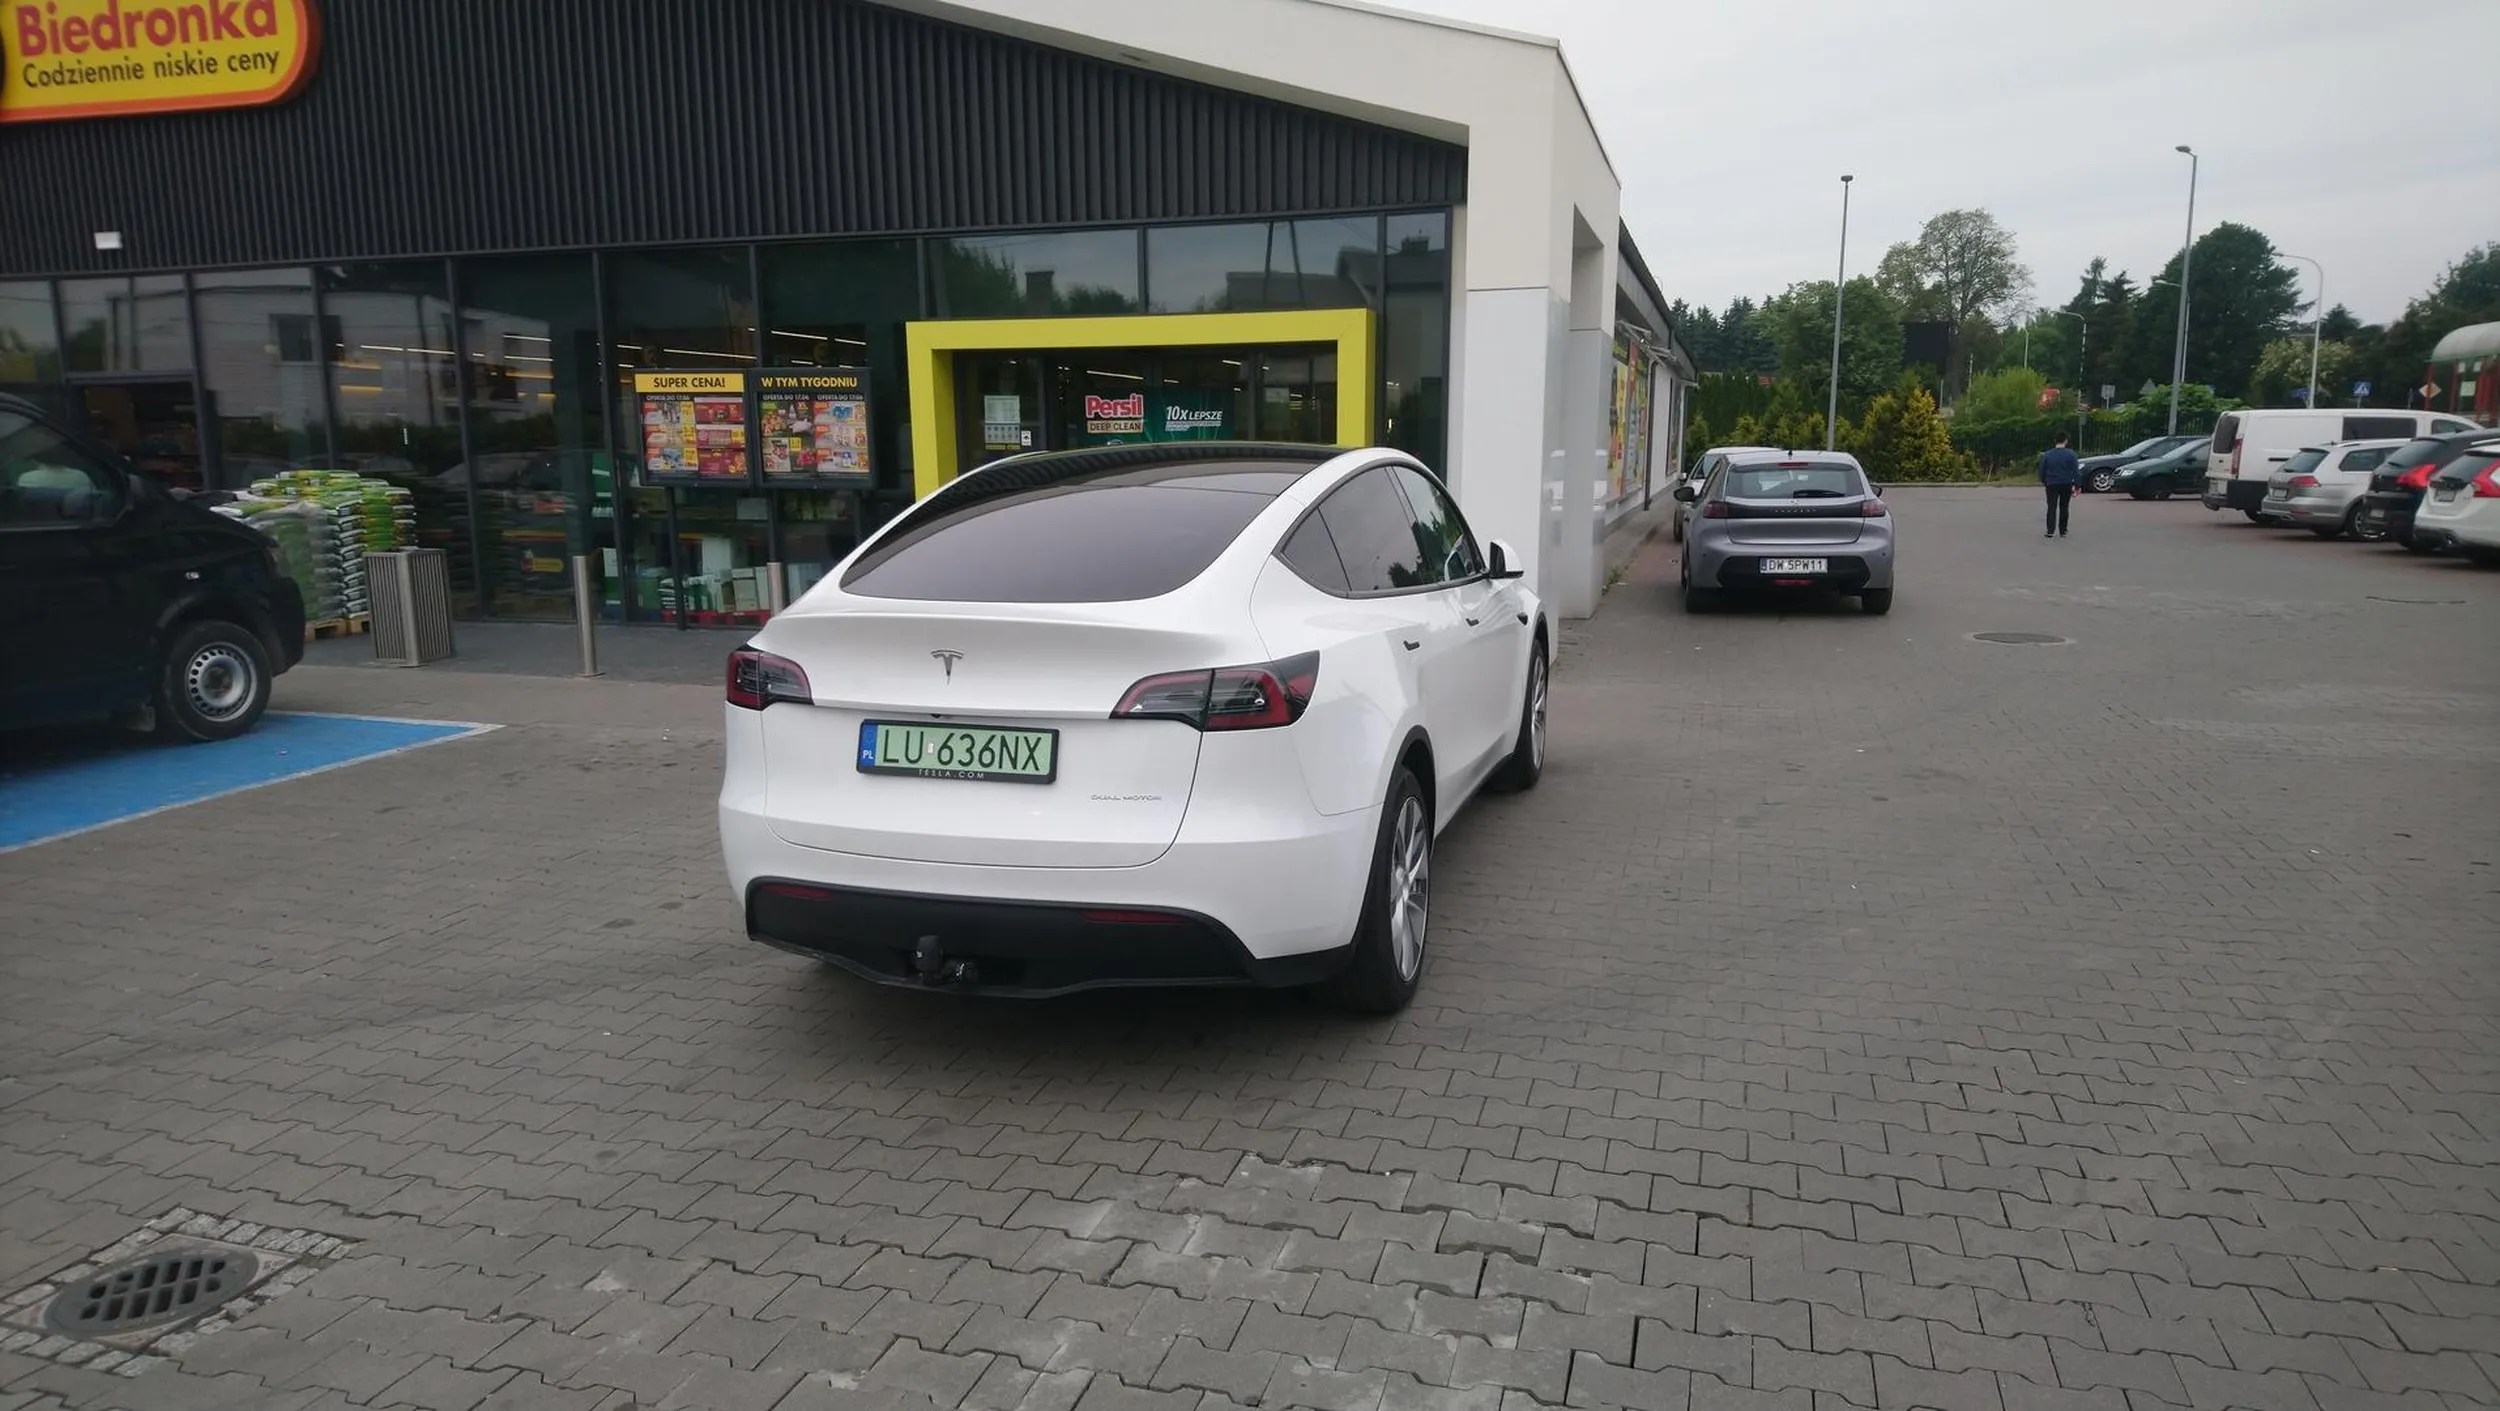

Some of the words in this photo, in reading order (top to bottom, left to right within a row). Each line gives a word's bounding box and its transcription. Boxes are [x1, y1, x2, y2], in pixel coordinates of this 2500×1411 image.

[16, 0, 278, 57] Biedronka
[23, 56, 145, 88] Codziennie
[154, 50, 217, 78] niskie
[227, 50, 279, 74] ceny
[653, 377, 688, 388] SUPER
[691, 377, 726, 388] CENA!
[761, 377, 774, 387] W
[776, 377, 798, 387] TYM
[800, 377, 857, 387] TYGODNIU
[1085, 393, 1144, 418] Persil
[1188, 410, 1223, 421] LEPSZE
[1090, 422, 1111, 431] DEEP
[1114, 421, 1141, 431] CLEAN
[862, 749, 874, 760] PL
[883, 729, 924, 764] LU
[937, 732, 1042, 772] 636NX
[918, 768, 985, 780] TESLA.COM
